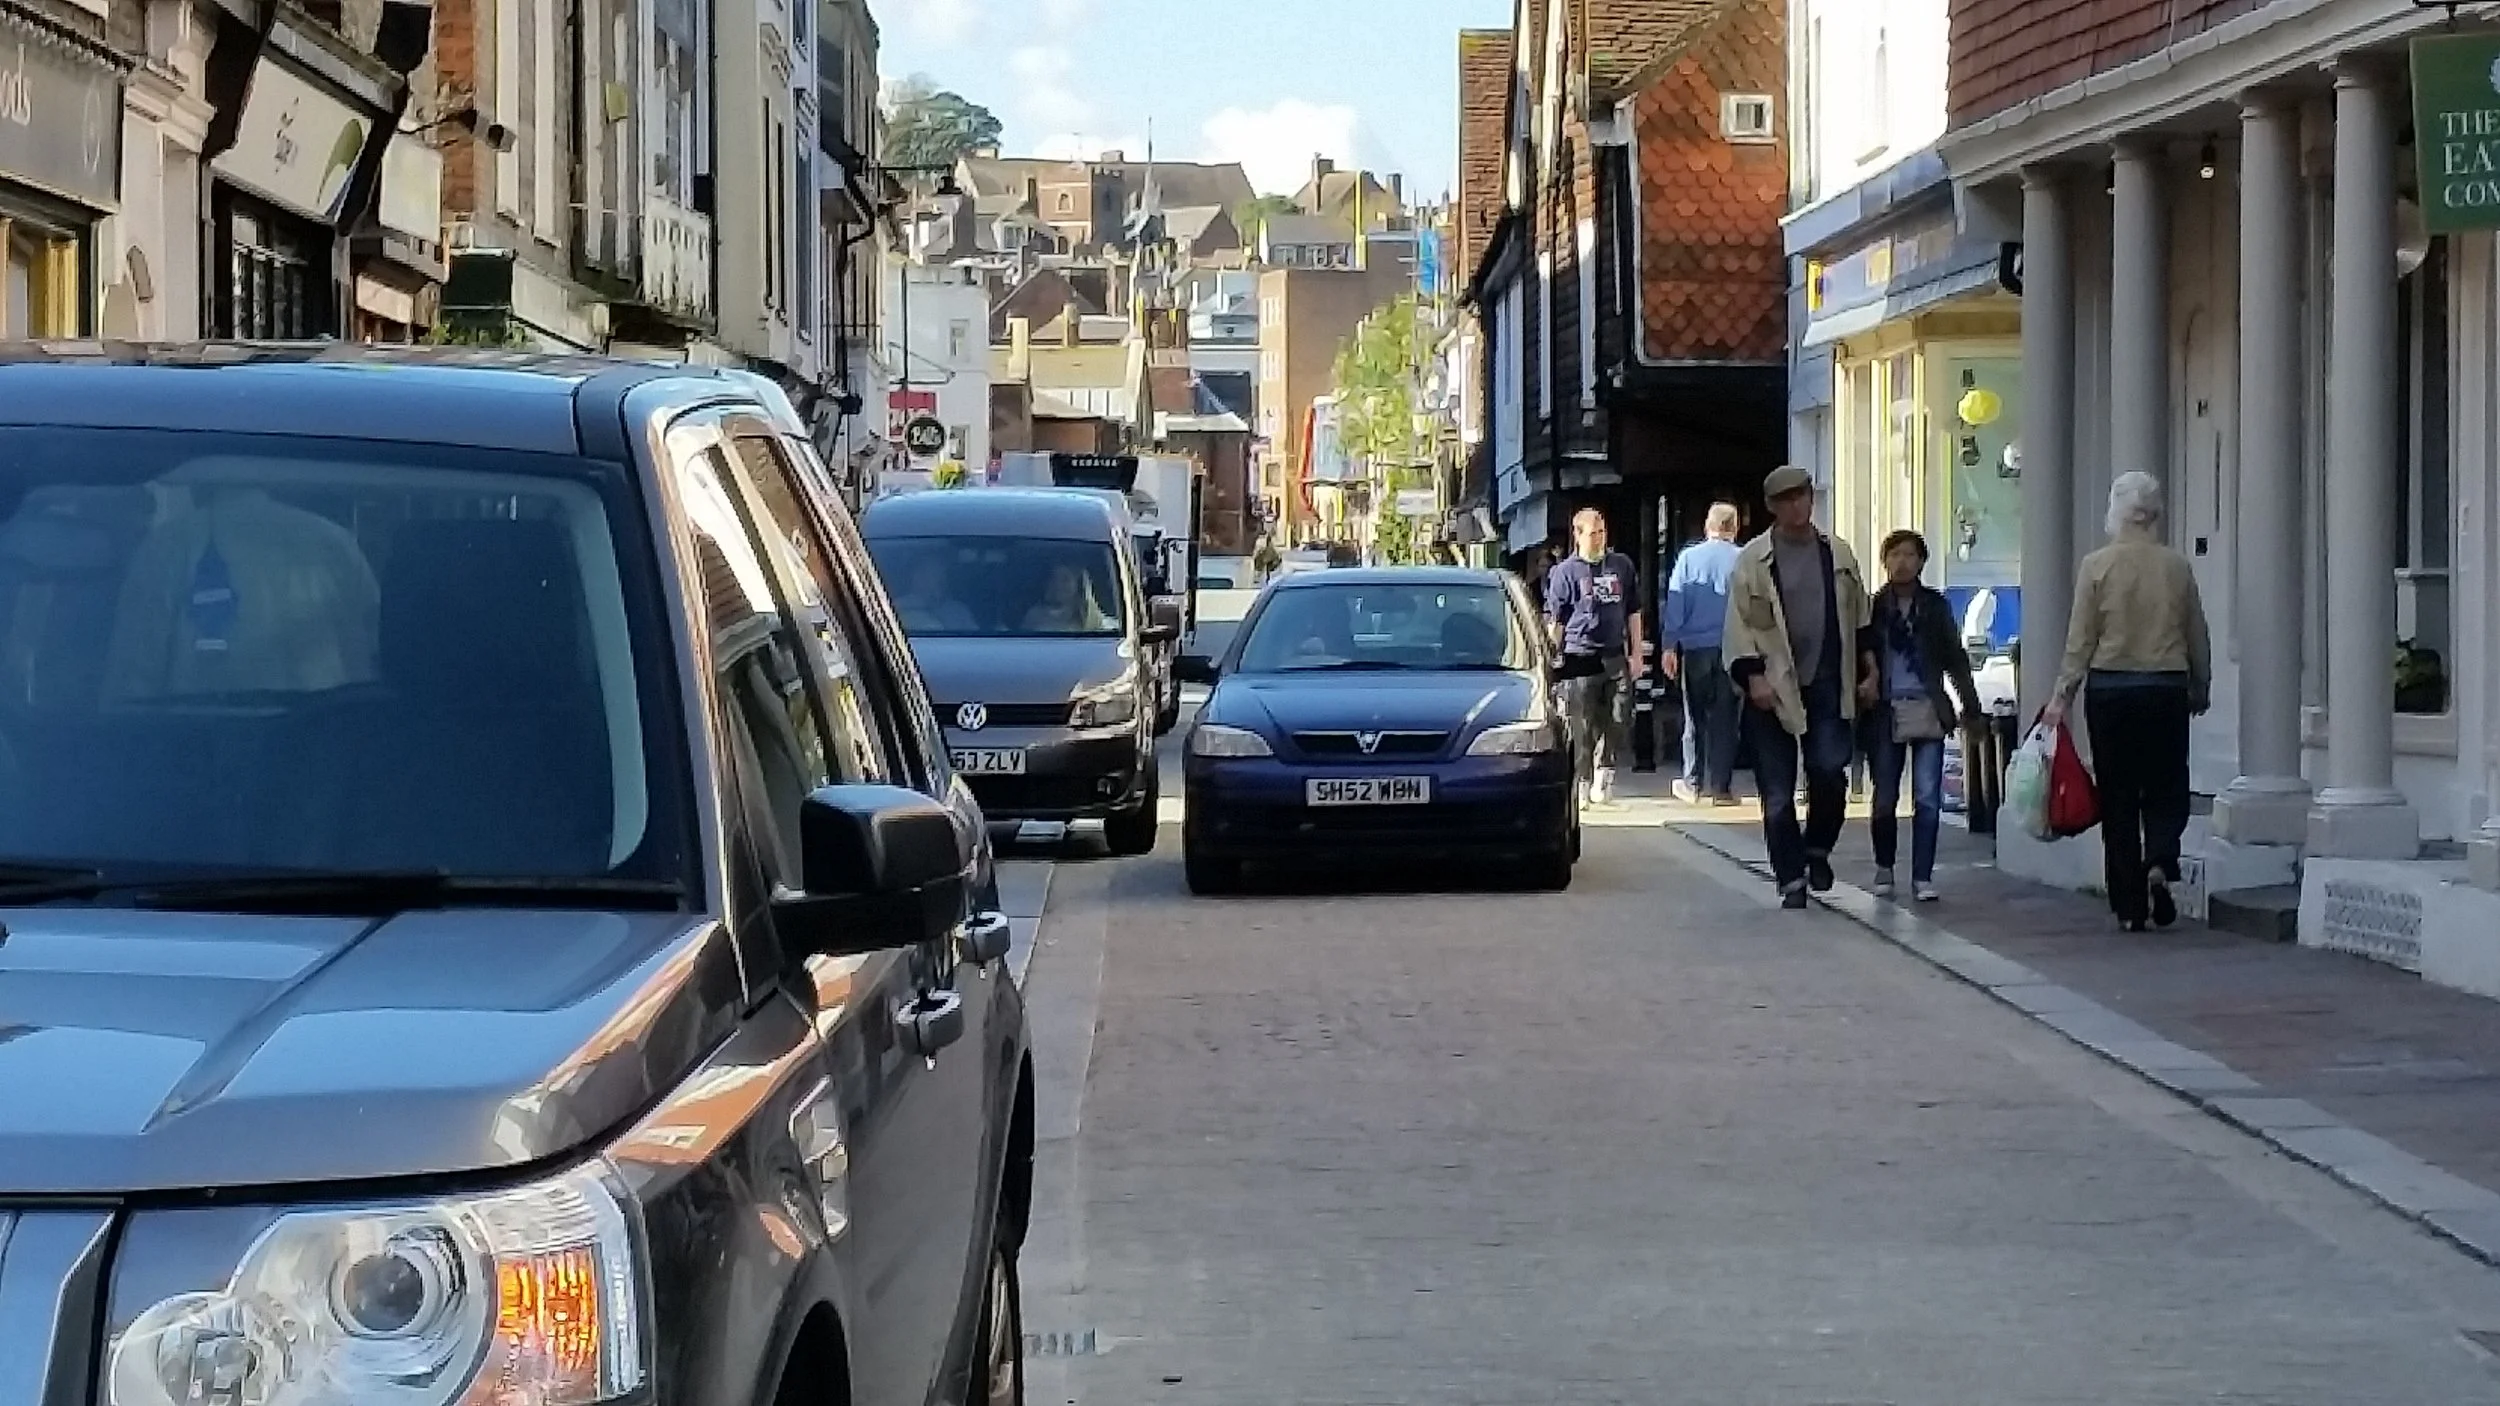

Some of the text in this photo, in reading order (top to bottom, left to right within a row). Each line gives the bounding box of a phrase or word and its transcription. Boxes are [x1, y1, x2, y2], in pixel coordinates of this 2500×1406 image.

[2439, 109, 2500, 138] THE
[984, 751, 1020, 770] ZLY
[1317, 781, 1373, 801] SH52
